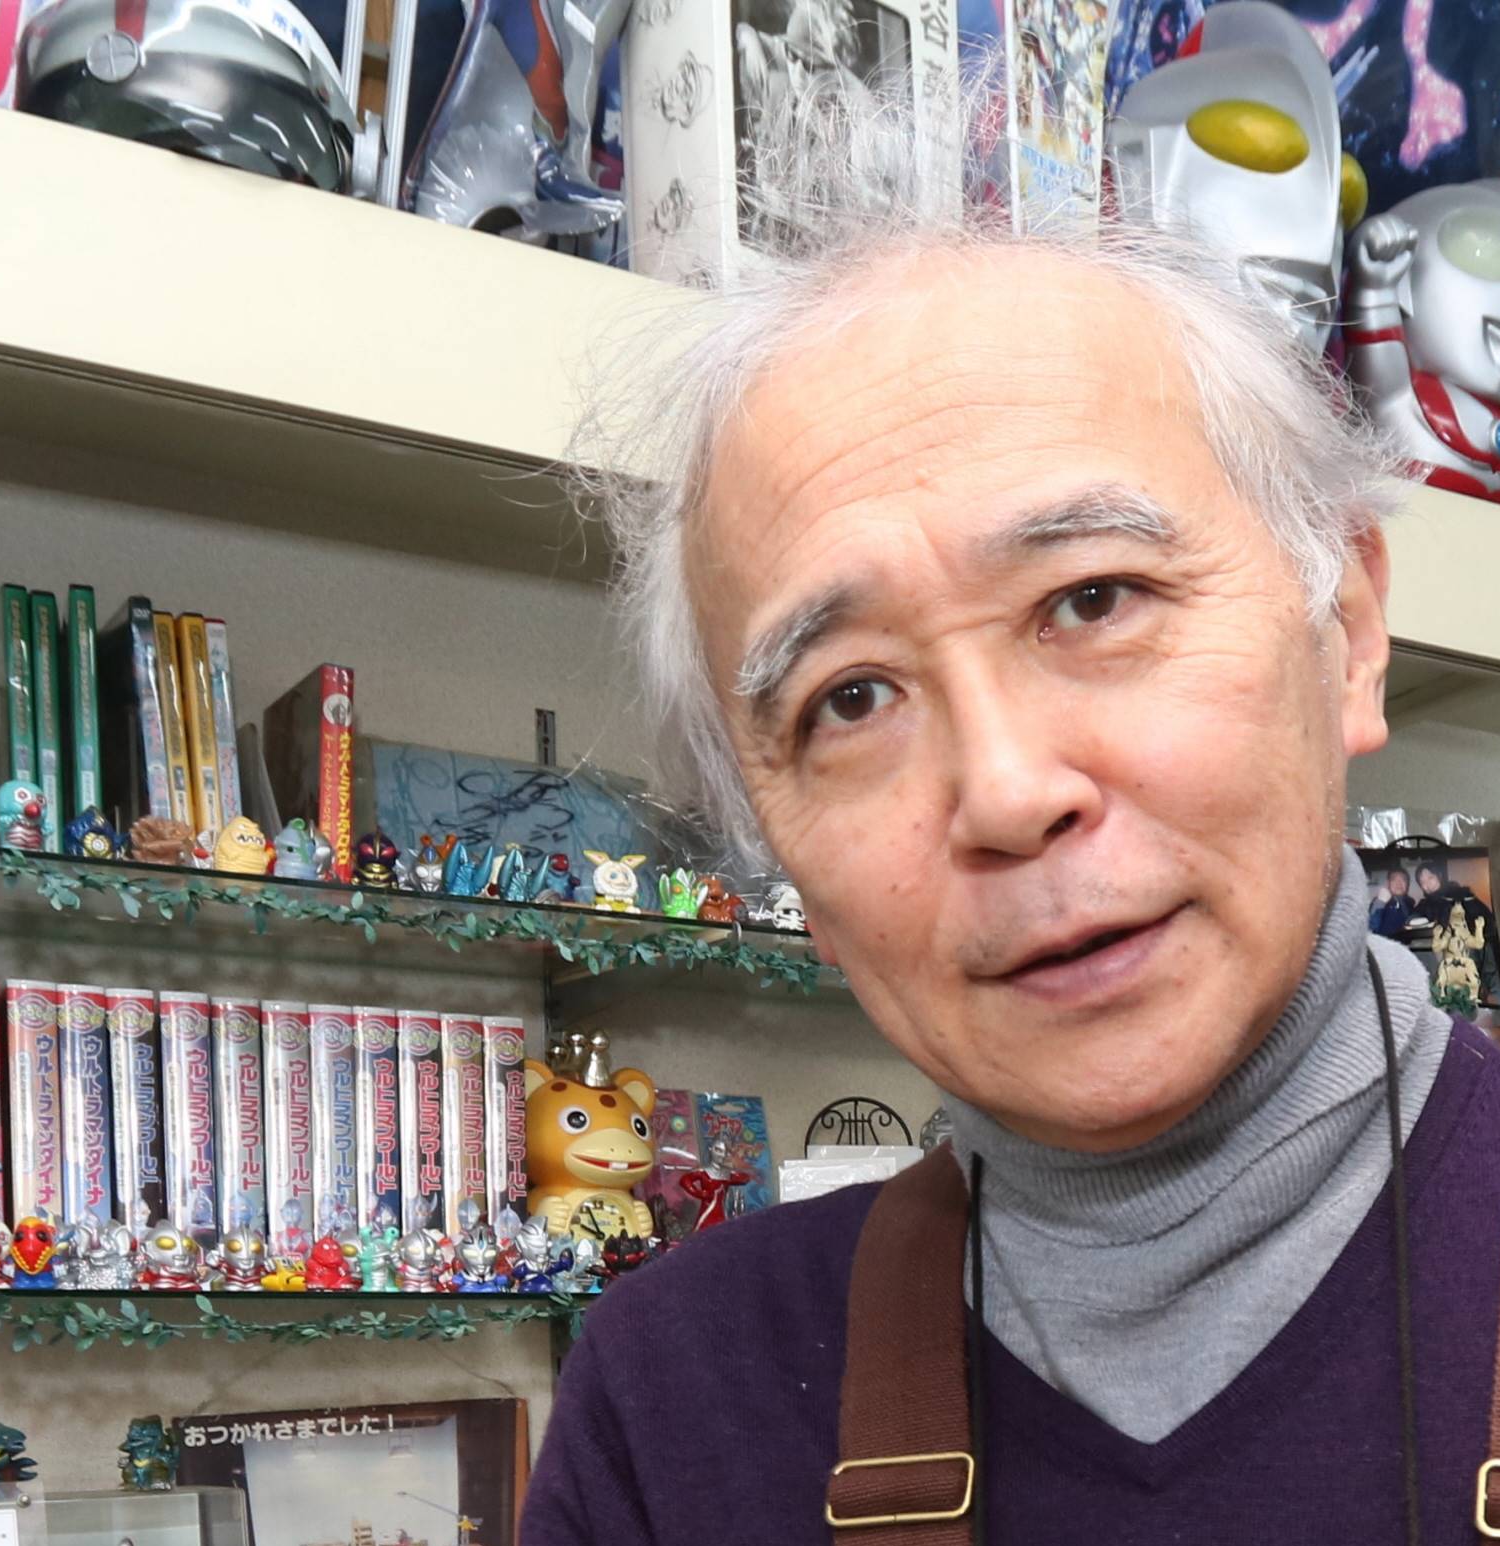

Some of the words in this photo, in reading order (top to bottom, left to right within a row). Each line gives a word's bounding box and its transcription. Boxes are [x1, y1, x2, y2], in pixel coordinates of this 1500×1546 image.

[184, 1414, 394, 1447] おつかれさまでした！
